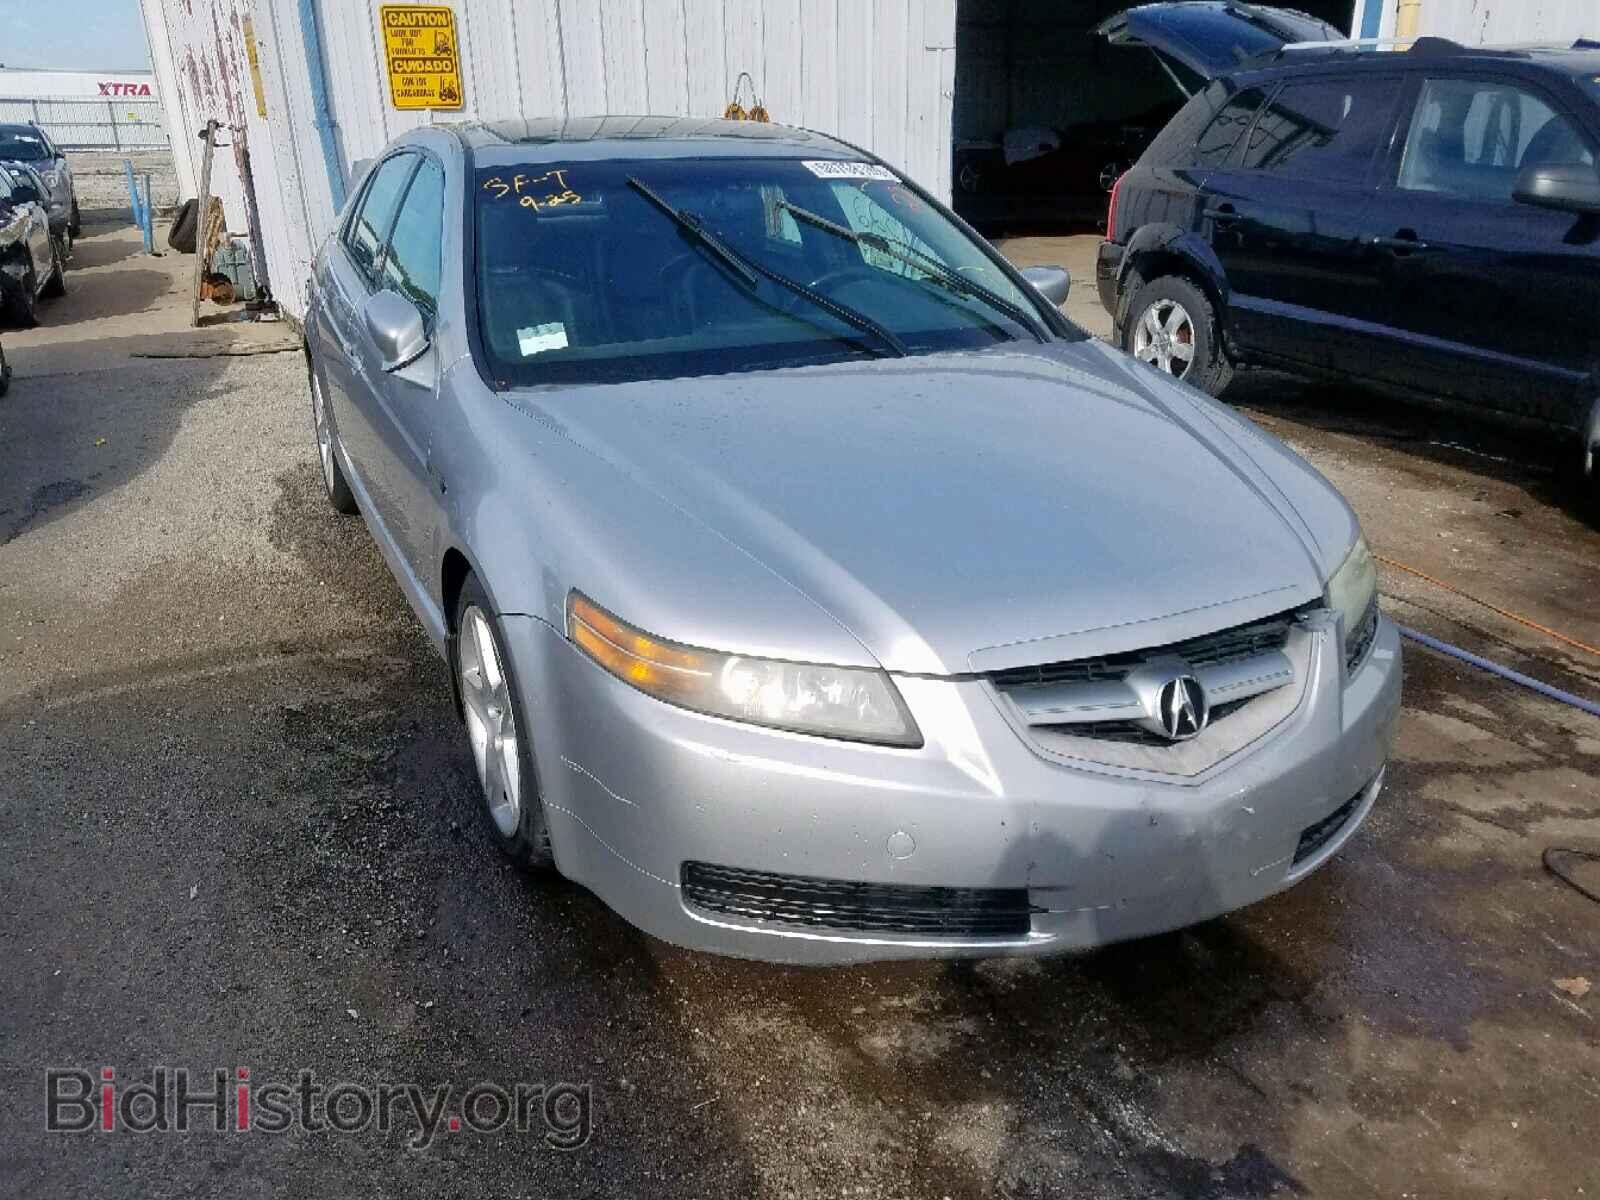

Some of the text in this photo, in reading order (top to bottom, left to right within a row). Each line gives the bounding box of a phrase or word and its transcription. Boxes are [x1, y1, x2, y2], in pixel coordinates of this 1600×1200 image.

[388, 12, 448, 26] CAUTION
[393, 60, 452, 73] CUIDADO
[97, 82, 152, 96] XTRA
